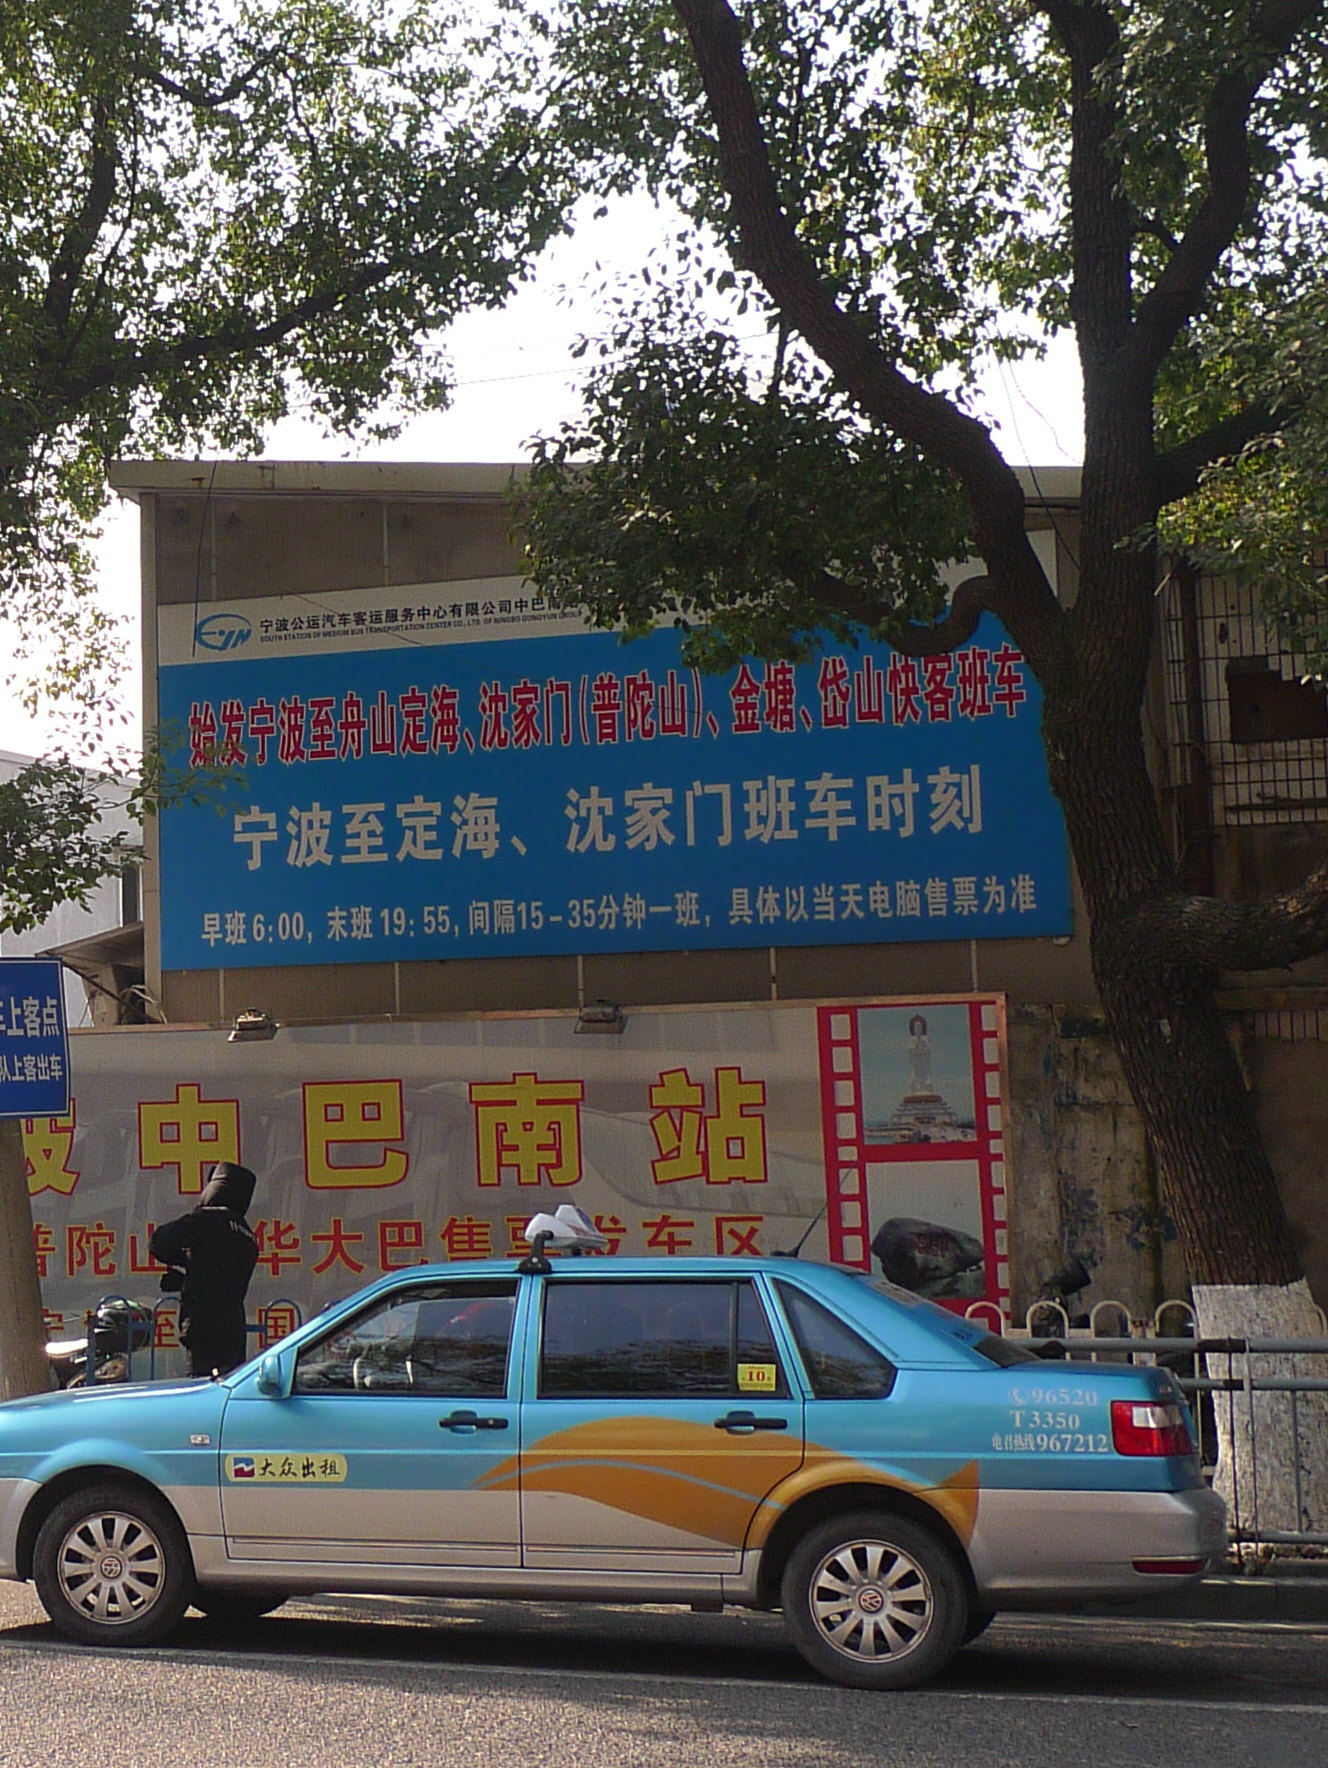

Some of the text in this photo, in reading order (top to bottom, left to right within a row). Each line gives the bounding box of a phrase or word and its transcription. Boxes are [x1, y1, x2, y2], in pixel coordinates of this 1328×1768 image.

[233, 764, 983, 872] 宁波至定海、沈家门班车时刻
[1030, 1388, 1098, 1406] 96520
[258, 1456, 341, 1479] 大众出租
